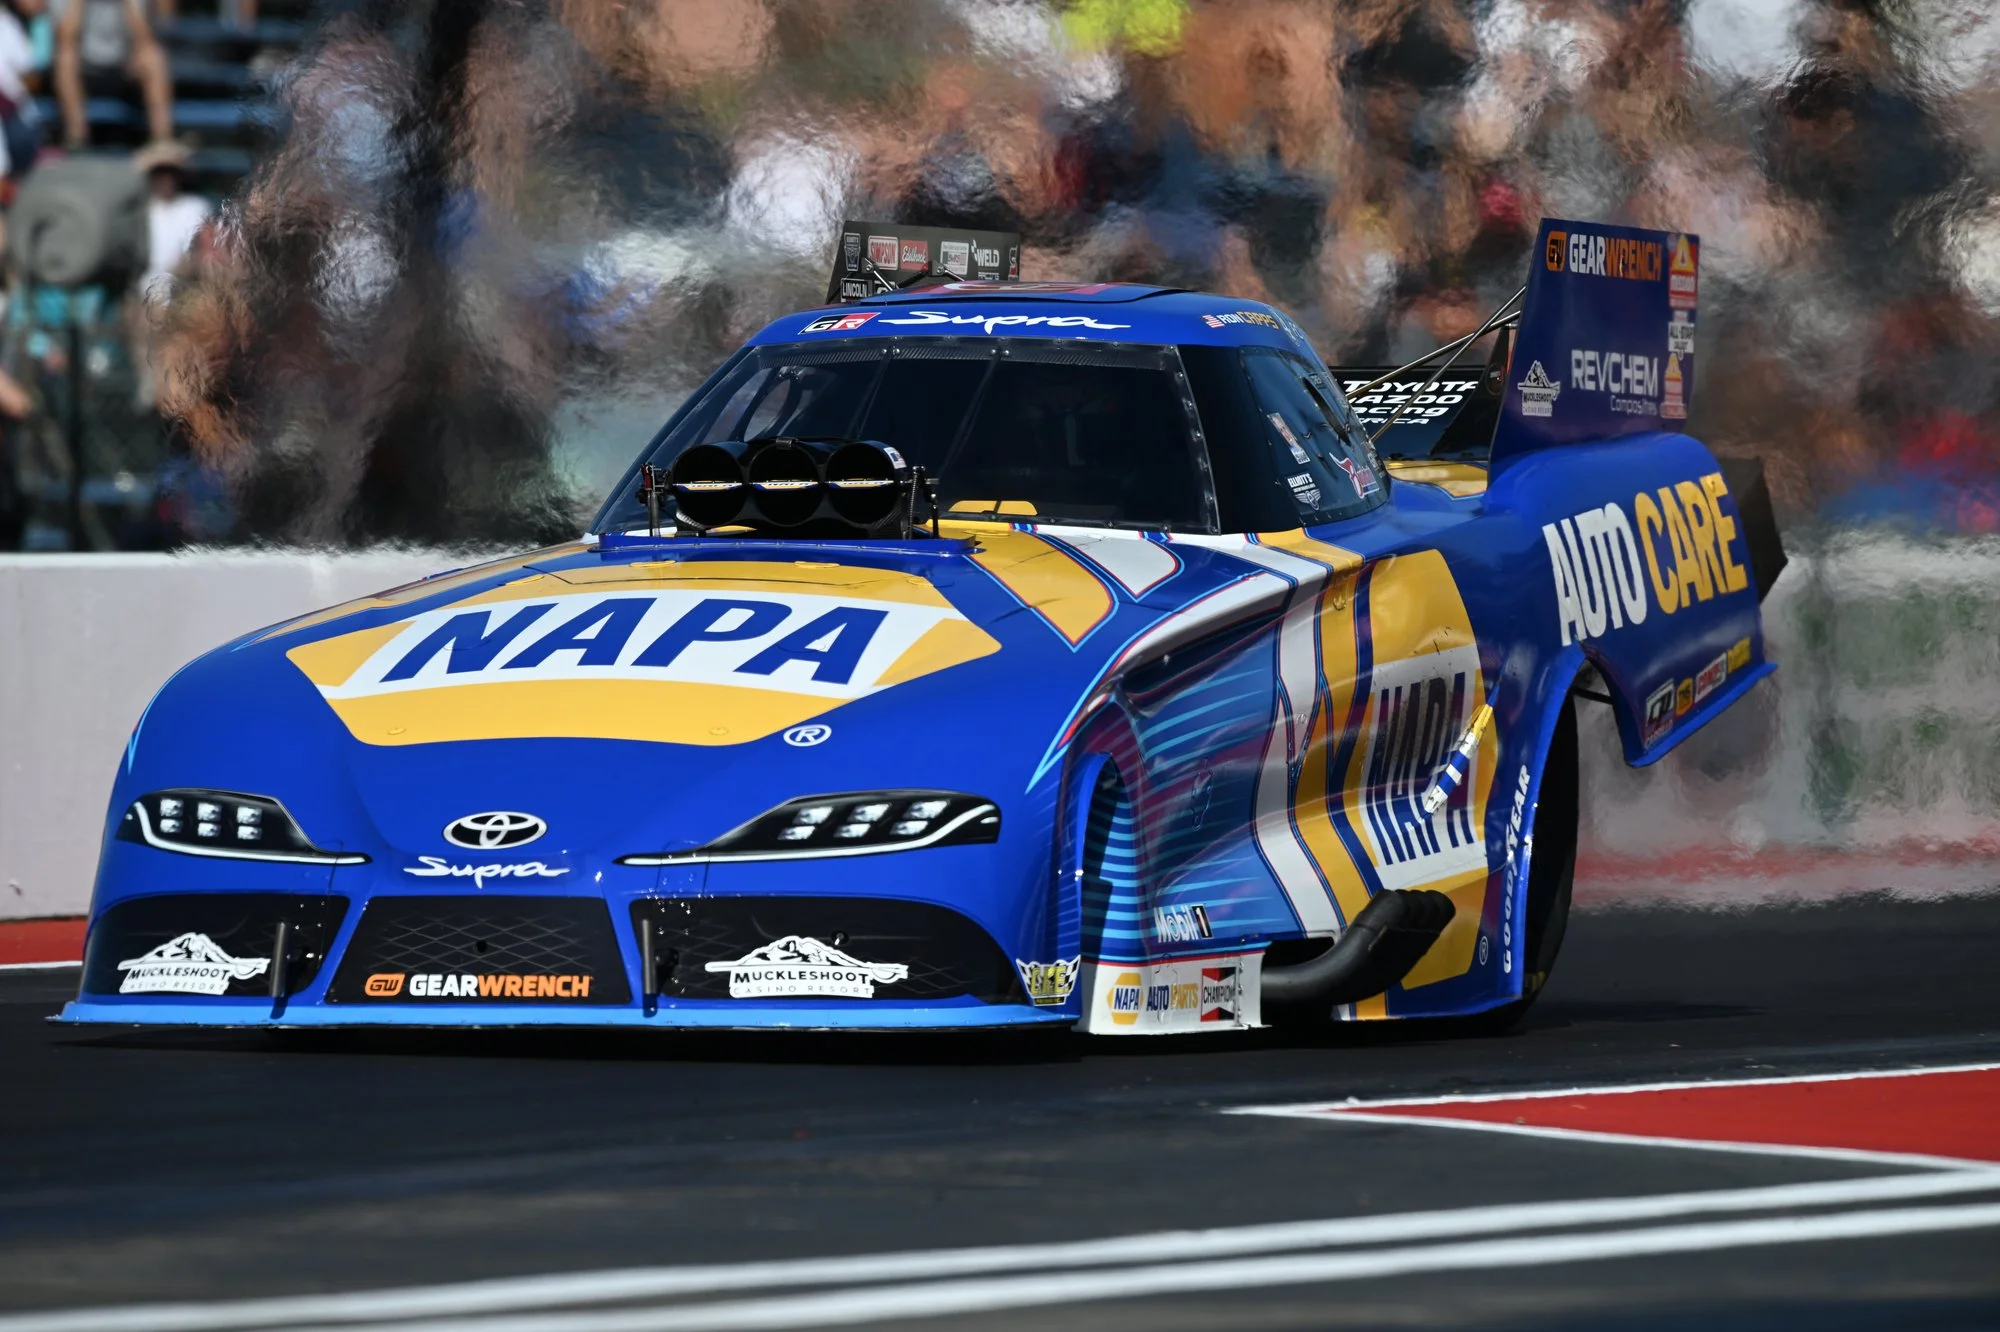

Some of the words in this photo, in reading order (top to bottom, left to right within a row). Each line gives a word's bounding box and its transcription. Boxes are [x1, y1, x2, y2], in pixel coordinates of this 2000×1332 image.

[870, 241, 897, 264] SIMPSON
[977, 249, 1000, 267] WELD
[1569, 233, 1662, 281] GEARWRENCH
[842, 283, 868, 298] LINCOLN
[805, 318, 865, 332] GR
[878, 311, 1131, 334] Supra
[1571, 350, 1658, 397] REVCHEM
[1343, 380, 1479, 393] TOYOTA
[1348, 394, 1463, 404] AZOO
[1353, 405, 1449, 417] acing
[1542, 502, 1647, 647] AUTO
[1634, 472, 1748, 615] CARE
[378, 596, 890, 686] NAPA
[1366, 671, 1475, 866] NAPA
[403, 855, 570, 889] Supra
[1153, 905, 1199, 943] Mobil
[129, 967, 230, 981] MUCKLESHOOT
[409, 973, 591, 998] GEARWRENCH
[734, 970, 869, 984] MUCKLESHOOT
[733, 985, 797, 996] CASINO
[807, 985, 871, 996] RESORT
[1113, 987, 1140, 1011] NAPA
[1146, 984, 1170, 1011] AUTO
[1170, 982, 1199, 1009] PARTS
